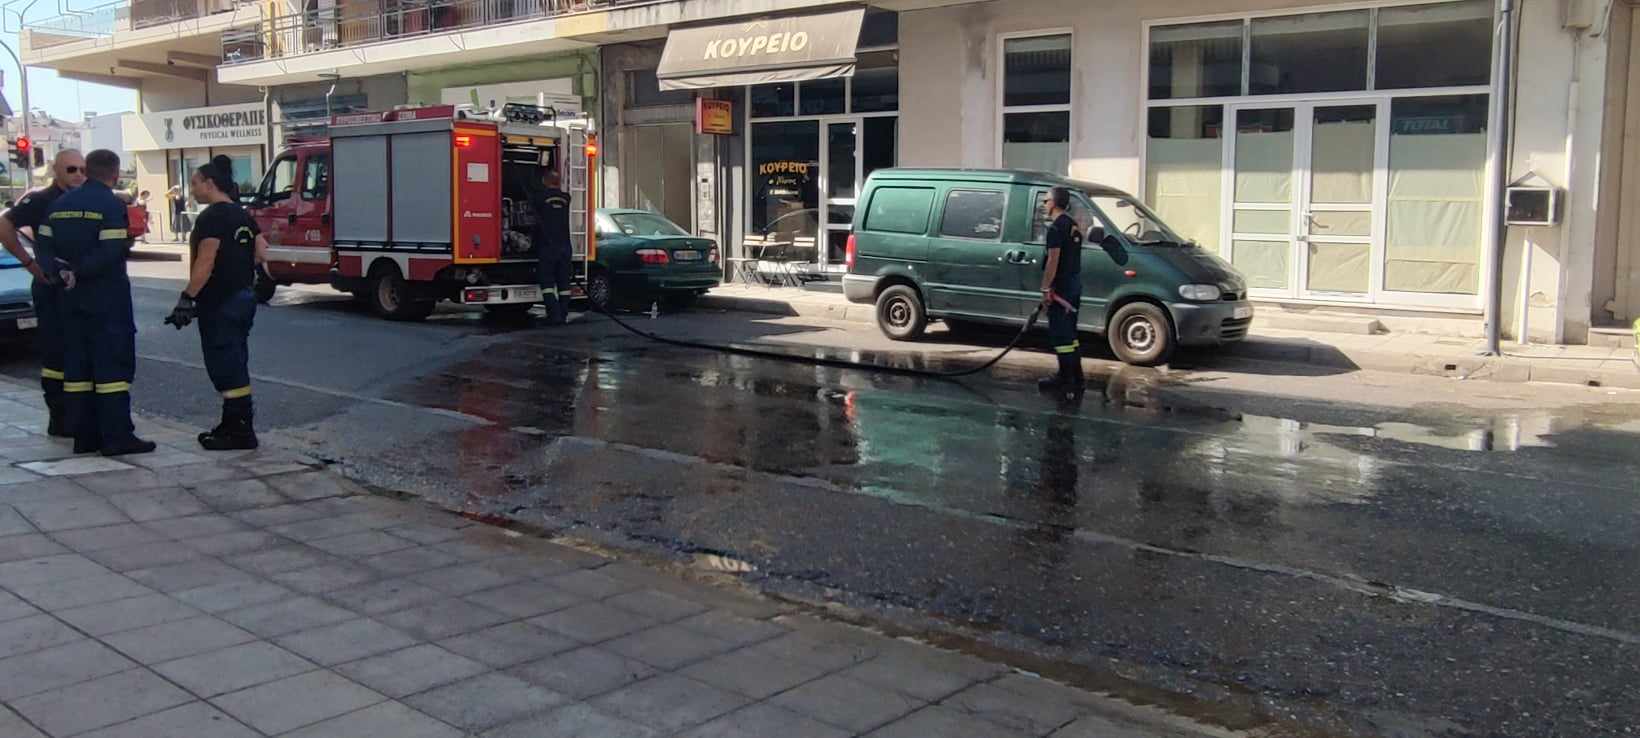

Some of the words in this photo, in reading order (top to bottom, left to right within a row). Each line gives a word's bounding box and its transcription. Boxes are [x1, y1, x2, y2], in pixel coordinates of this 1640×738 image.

[703, 31, 808, 60] ΚΟΥΡΕΙΟ
[200, 129, 229, 140] PHYSICAL
[231, 128, 262, 138] WELLNESS
[759, 161, 807, 175] ΚΟΥΡΕΙΟ
